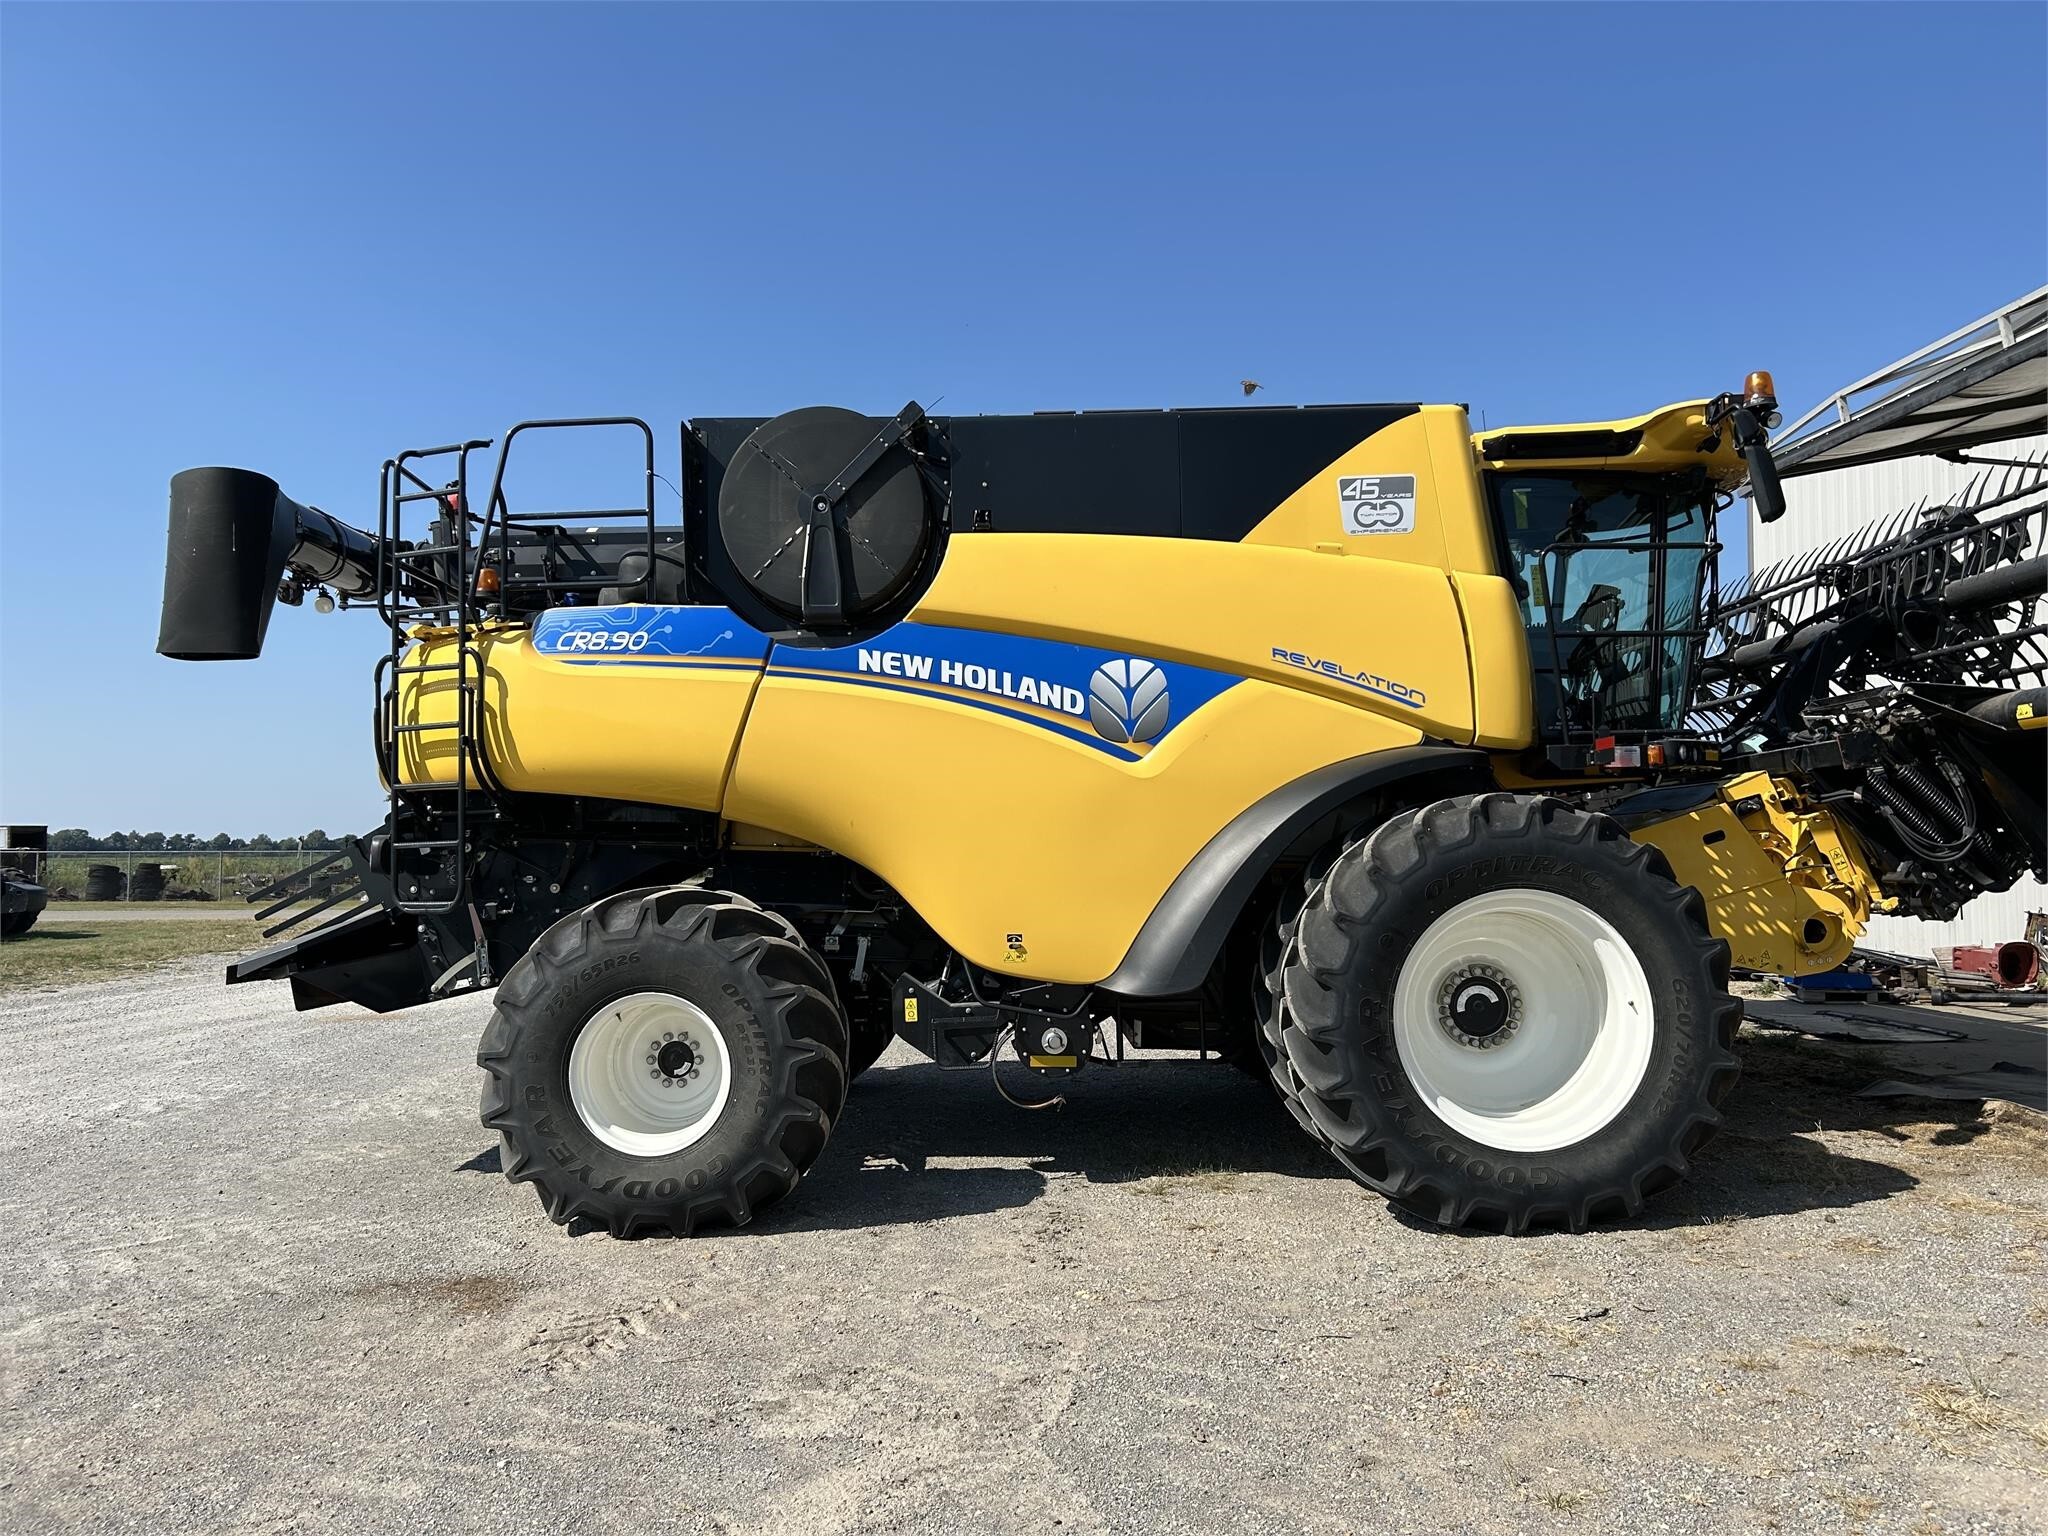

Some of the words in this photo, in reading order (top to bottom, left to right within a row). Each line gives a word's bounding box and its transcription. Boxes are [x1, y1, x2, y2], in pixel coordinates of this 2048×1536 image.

[1342, 478, 1380, 500] 45
[1350, 527, 1409, 535] EXPERIENCE
[556, 631, 649, 651] CR8.90
[858, 648, 933, 680] NEW
[940, 659, 1085, 716] HOLLAND
[1271, 647, 1426, 704] REVELATION
[1424, 855, 1605, 899] OPTITRAC
[721, 983, 772, 1118] OPTITRAC
[1359, 997, 1560, 1191] GOODYEAR
[523, 1084, 732, 1200] GOODYEAR
